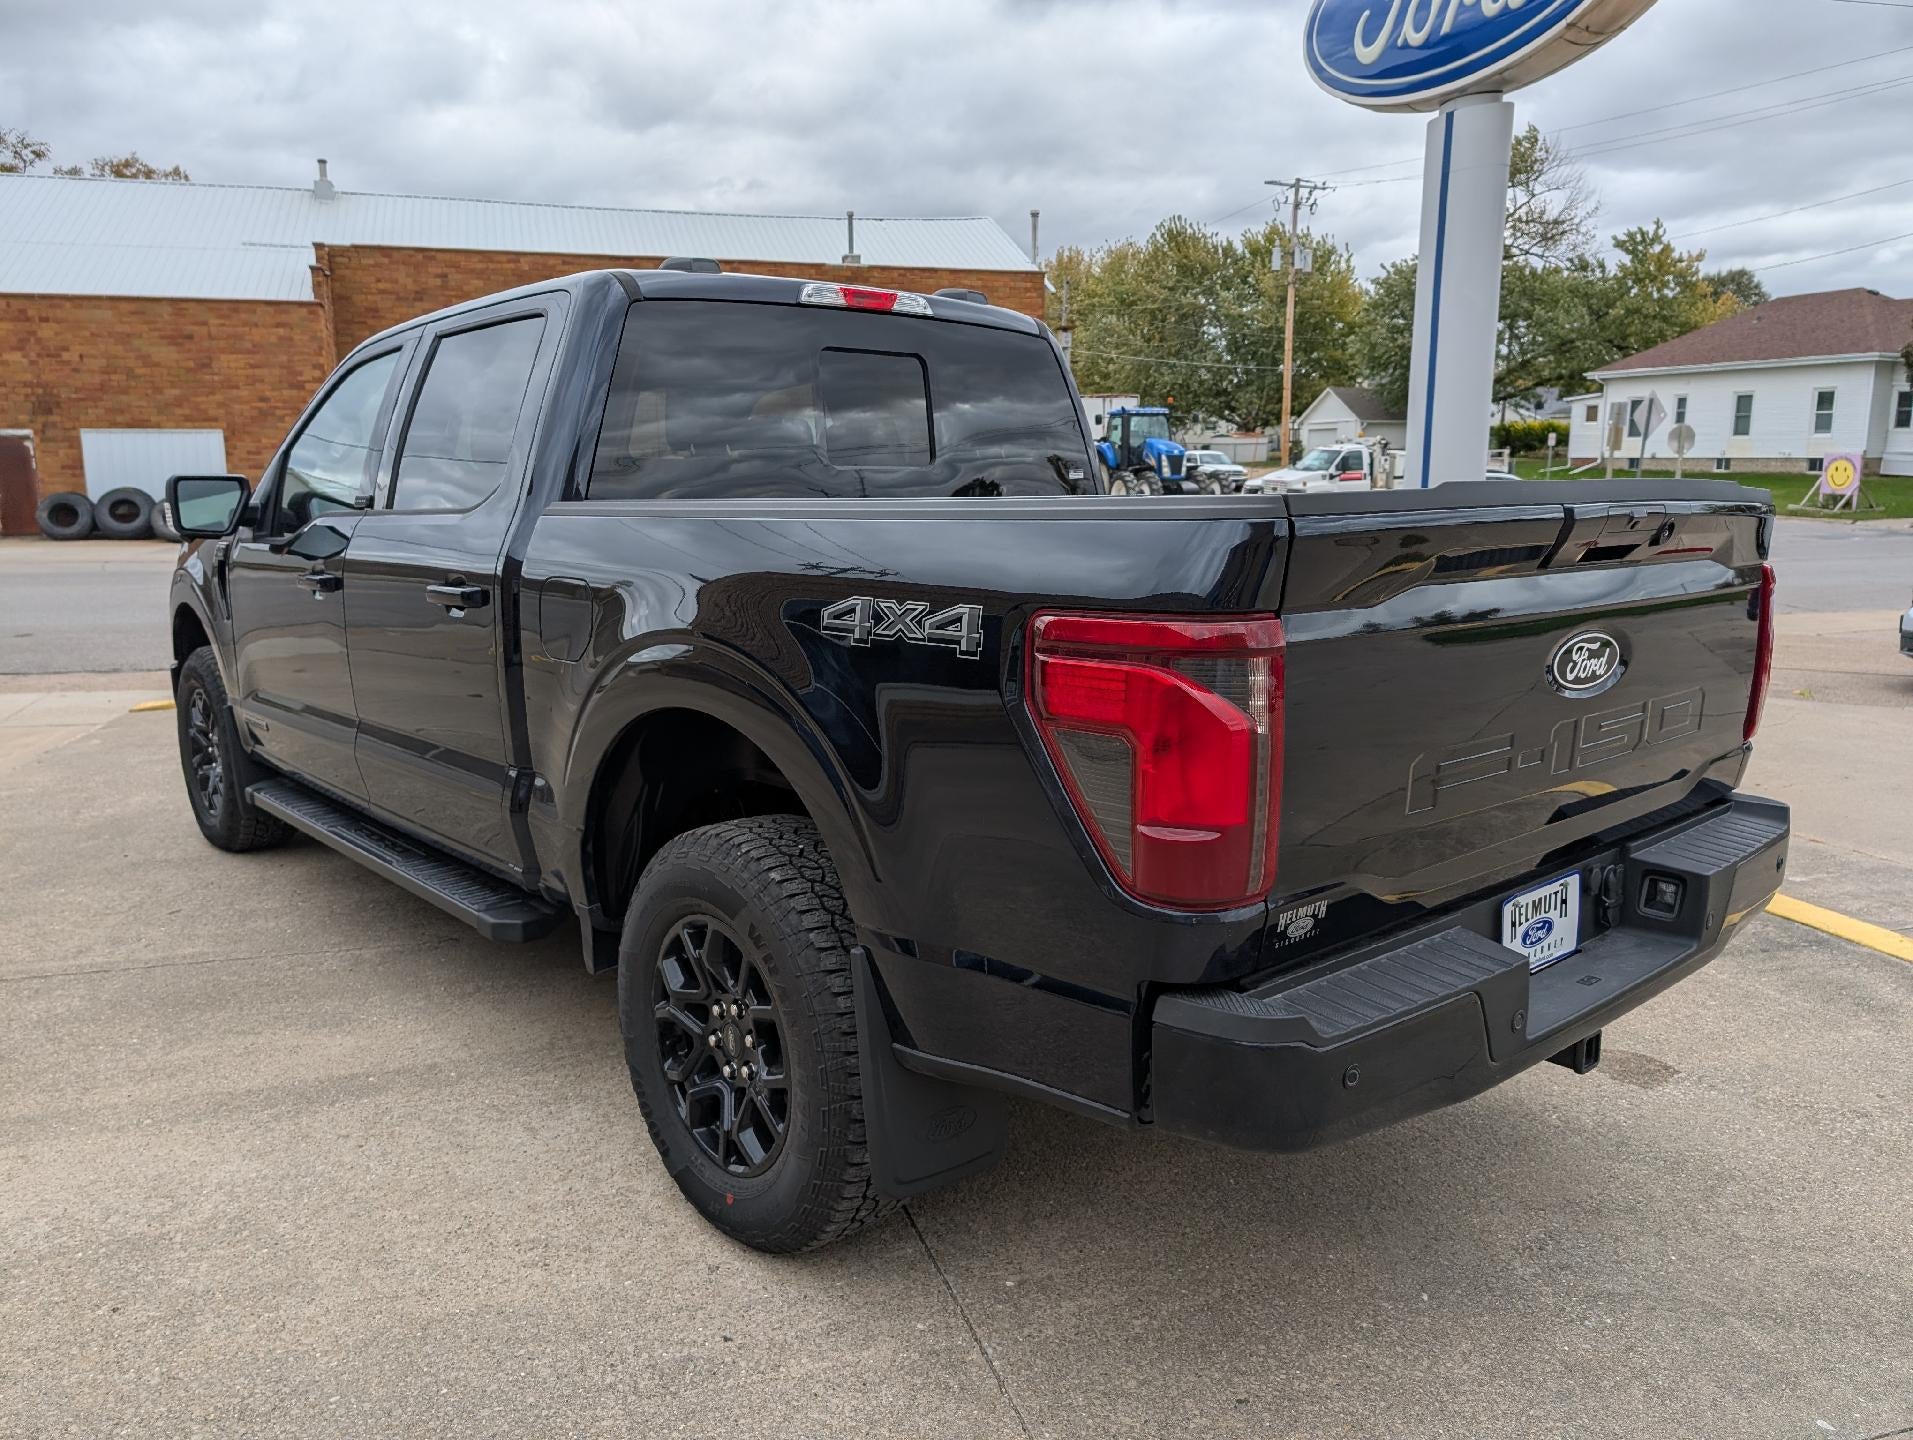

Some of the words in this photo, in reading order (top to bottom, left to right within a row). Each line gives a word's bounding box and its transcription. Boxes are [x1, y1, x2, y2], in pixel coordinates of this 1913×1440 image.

[1566, 641, 1610, 681] Ford
[1406, 687, 1705, 816] F-150
[1277, 900, 1328, 933] HELMUTH
[1510, 883, 1569, 944] HELMUTH
[1526, 922, 1549, 945] Ford
